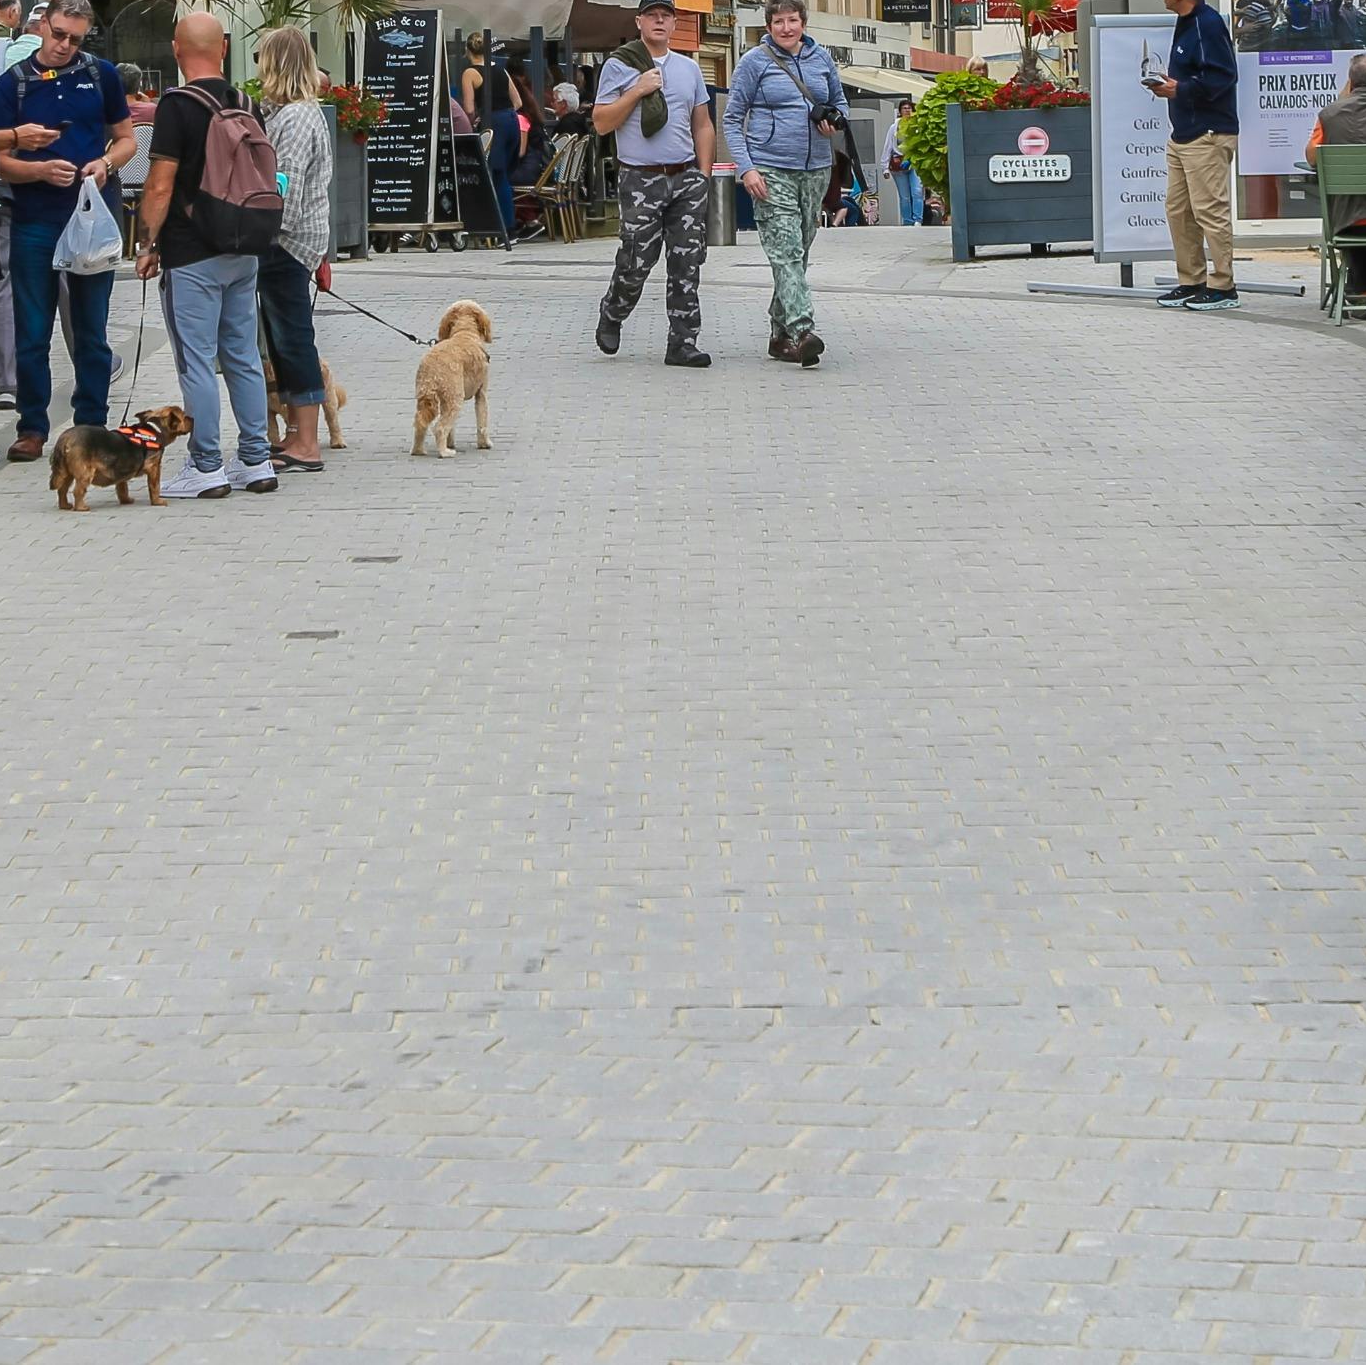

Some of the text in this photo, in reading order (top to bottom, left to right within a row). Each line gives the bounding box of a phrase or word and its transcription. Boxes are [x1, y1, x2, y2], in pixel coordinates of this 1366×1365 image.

[401, 16, 410, 26] &
[1259, 73, 1337, 92] PRIX BAYEUX
[1133, 117, 1160, 130] Café
[1125, 142, 1165, 157] Crêpes
[992, 169, 1068, 178] PIED À TERRE
[1121, 166, 1168, 179] Gaufres
[1127, 215, 1166, 227] Glaces
